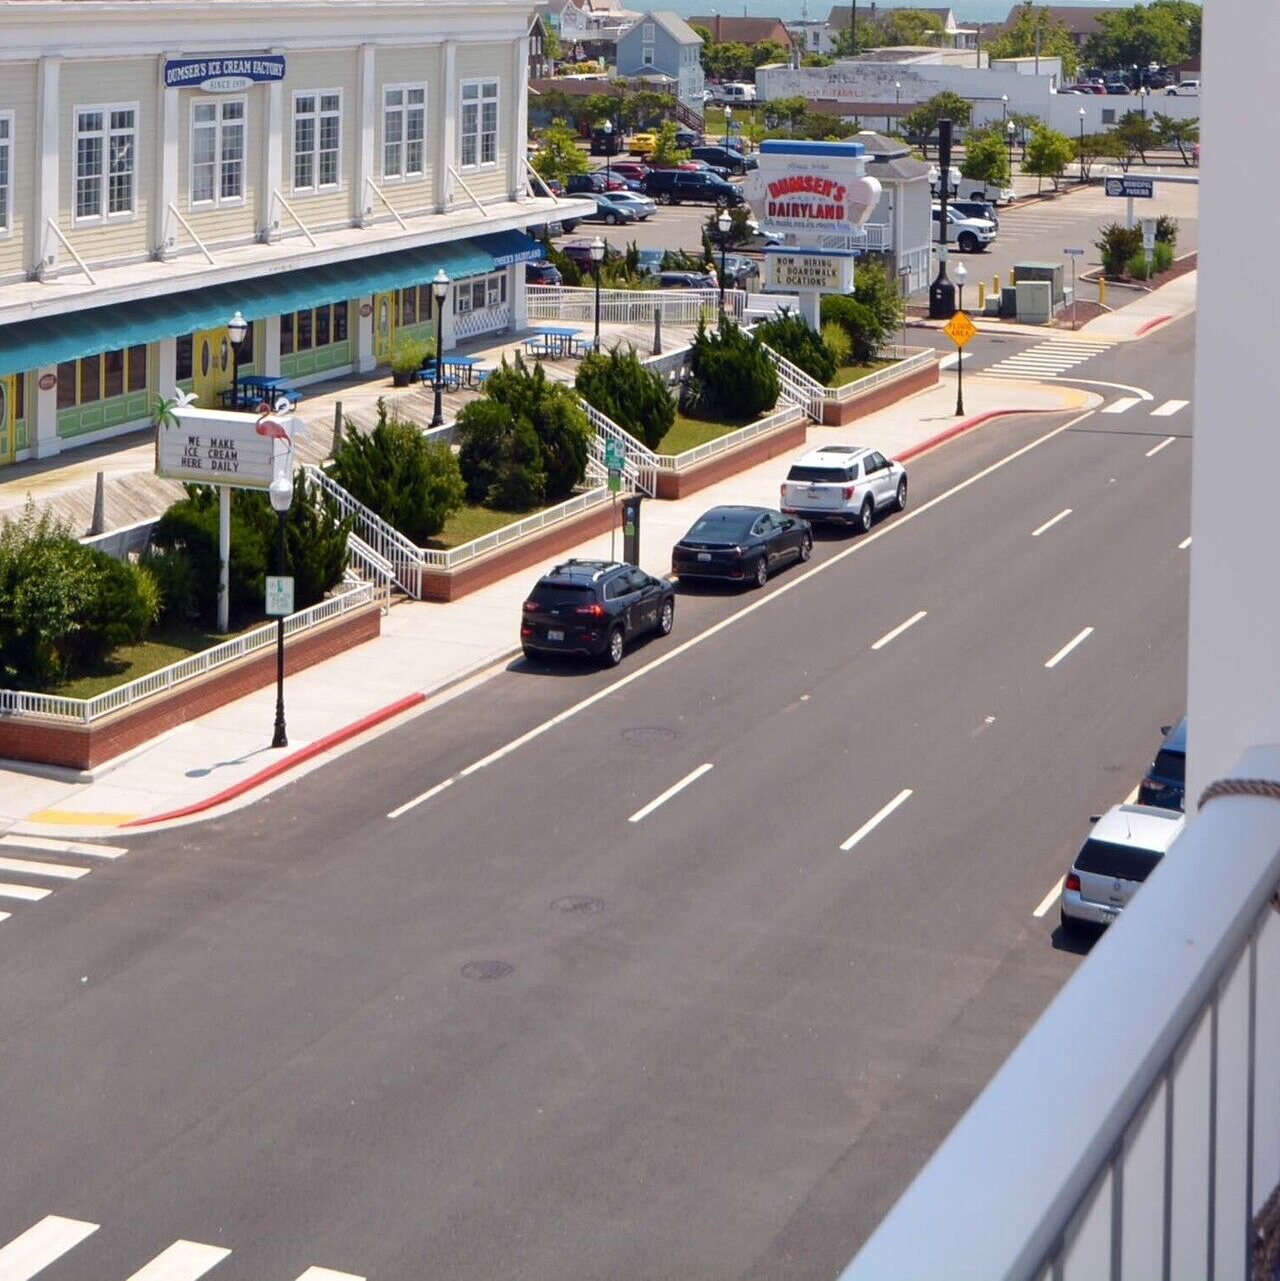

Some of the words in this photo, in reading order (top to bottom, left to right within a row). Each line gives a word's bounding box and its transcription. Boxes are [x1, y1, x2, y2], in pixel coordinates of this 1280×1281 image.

[167, 63, 207, 83] DUMSER'S
[208, 62, 221, 75] ICE
[223, 60, 251, 74] CREAM
[253, 60, 283, 76] FACTORY
[768, 175, 847, 202] DUMSER'S
[1123, 180, 1152, 188] MUNICIPAL
[768, 202, 844, 220] DAIRYLAND
[777, 257, 794, 265] NOW
[803, 259, 832, 268] HIRING
[787, 266, 837, 278] BOARDWALK
[188, 436, 200, 447] WE
[210, 437, 235, 449] MAKE
[184, 446, 198, 457] ICE
[208, 449, 237, 460] CREAM
[181, 457, 202, 468] HERE
[211, 460, 239, 472] DAILY
